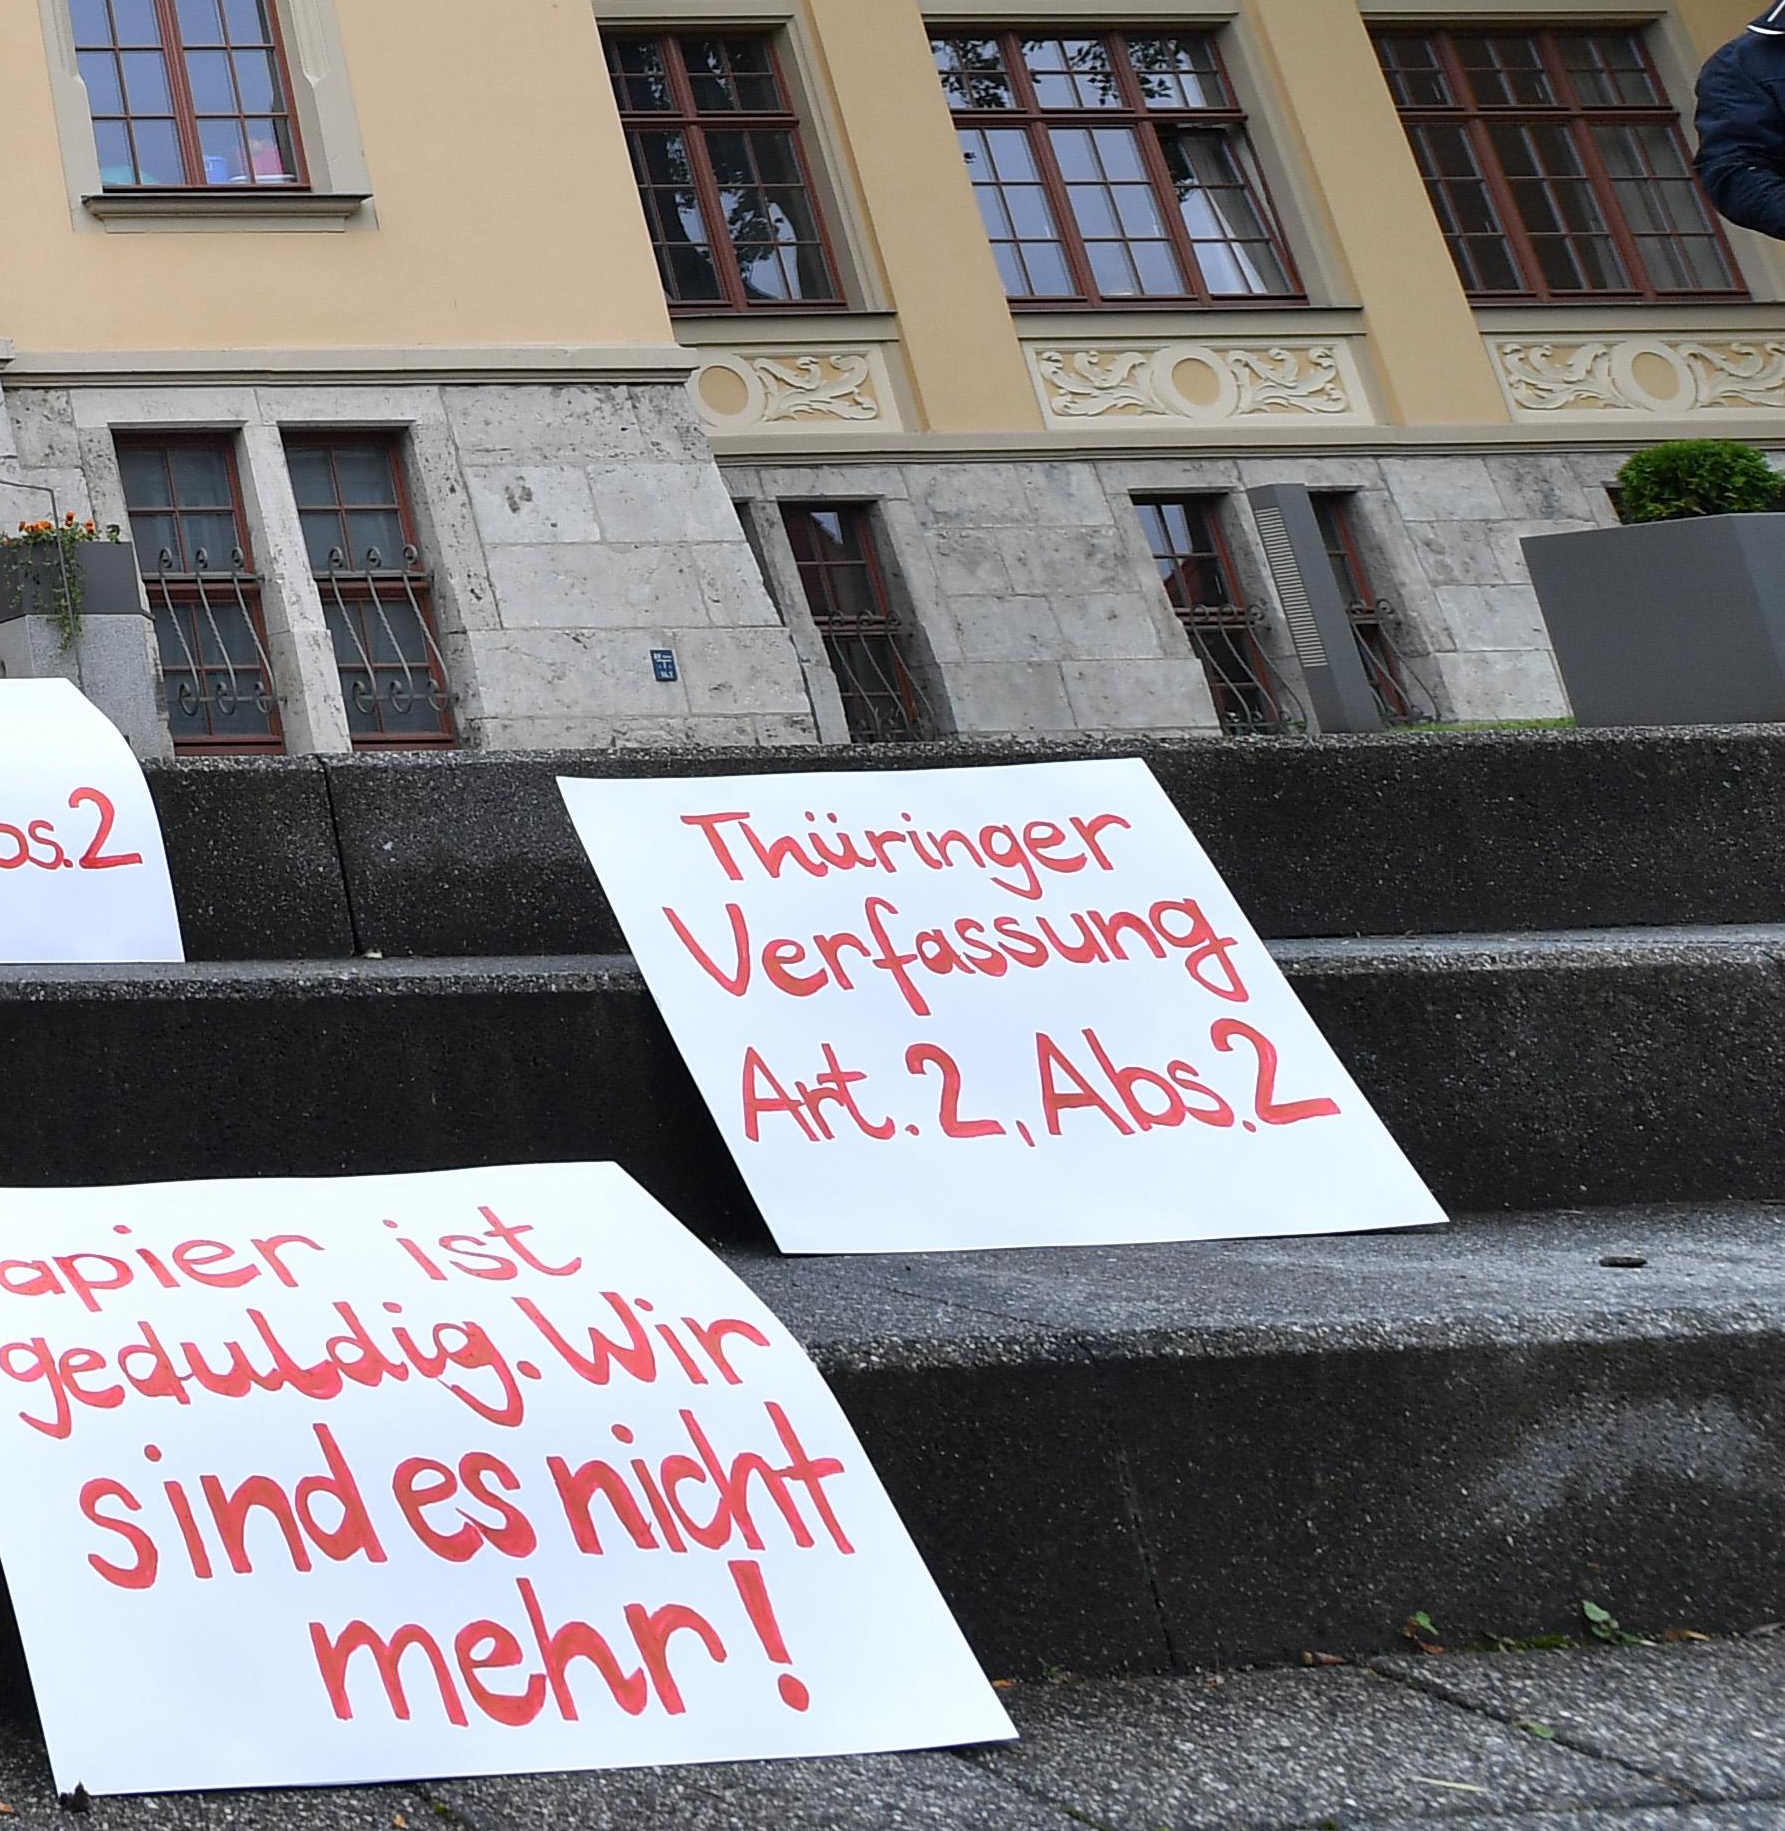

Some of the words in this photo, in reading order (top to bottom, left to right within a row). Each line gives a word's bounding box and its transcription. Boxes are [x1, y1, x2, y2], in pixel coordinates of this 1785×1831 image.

[680, 811, 1130, 900] Thüringer
[663, 897, 1249, 1017] Verfassung
[381, 1205, 584, 1282] ist
[515, 1290, 771, 1387] Wir
[78, 1422, 387, 1591] sind
[391, 1448, 538, 1563] es
[545, 1400, 855, 1557] nicht
[309, 1560, 811, 1728] mehr!
